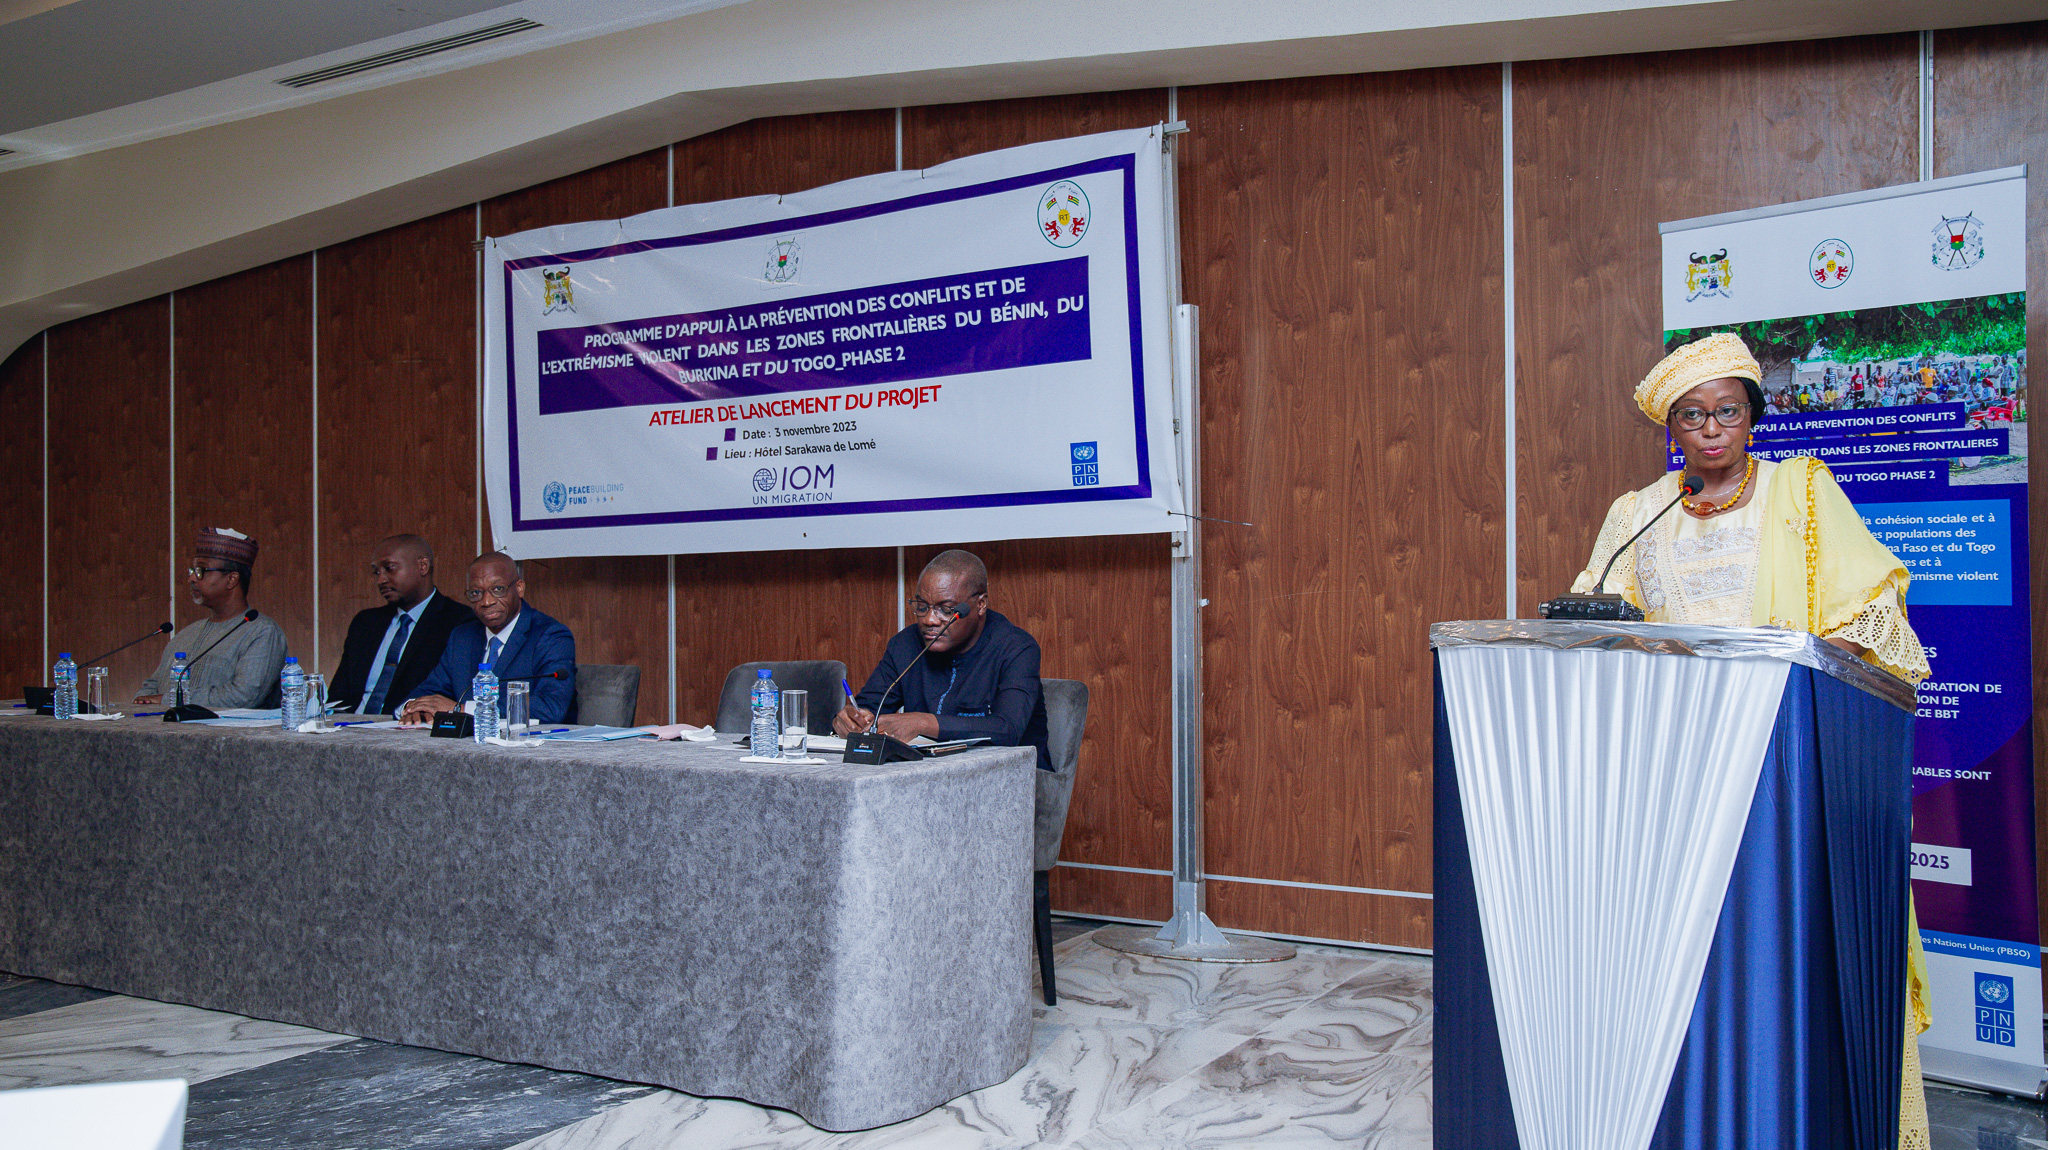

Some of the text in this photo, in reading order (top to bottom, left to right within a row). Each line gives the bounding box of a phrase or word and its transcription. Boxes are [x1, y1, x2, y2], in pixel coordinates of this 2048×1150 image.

[584, 326, 663, 348] PROGRAMME
[726, 314, 738, 332] À
[740, 315, 758, 330] LA
[760, 301, 853, 327] PRÉVENTION
[857, 296, 886, 314] DES
[890, 284, 971, 309] CONFLITS
[975, 280, 997, 298] ET
[1001, 277, 1026, 295] DE
[638, 346, 691, 365] VIOLENT
[698, 341, 739, 358] DANS
[746, 338, 770, 353] LES
[776, 330, 825, 350] ZONES
[832, 314, 946, 343] FRONTALIÈRES
[955, 309, 981, 327] DU
[990, 301, 1049, 323] BÉNIN,
[1057, 295, 1084, 314] DU
[678, 346, 906, 384] BURKINA ET DU TOGO_PHASE 2
[649, 384, 942, 427] ATELIER DE LANCEMENT DU PROJET
[1778, 423, 1788, 431] A
[1789, 422, 1803, 431] LA
[1805, 417, 1874, 430] PREVENTION
[1876, 415, 1897, 425] DES
[1899, 411, 1957, 424] CONFLITS
[742, 430, 766, 440] Date
[774, 427, 781, 437] 3
[783, 424, 831, 437] novembre
[832, 420, 857, 433] 2023
[724, 448, 746, 459] Lieu
[754, 446, 782, 459] Hôtel
[785, 443, 832, 456] Sarakawa
[833, 441, 846, 452] de
[848, 438, 876, 452] Lomé
[1672, 455, 1686, 464] ET
[1773, 448, 1819, 459] VIOLENT
[1820, 446, 1851, 456] DANS
[1853, 445, 1871, 454] LES
[1873, 443, 1911, 454] ZONES
[1912, 438, 1999, 452] FRONTALIERES
[781, 463, 834, 491] IOM
[1836, 470, 1936, 483] DU TOGO PHASE 2
[568, 483, 624, 495] PEACEBUILDING
[569, 496, 588, 505] FUND
[752, 492, 834, 505] UN MIGRATION
[1874, 514, 1924, 525] cohésion
[1927, 513, 1968, 524] sociale
[1971, 514, 1985, 523] et
[1988, 512, 1996, 523] à
[1885, 529, 1952, 541] populations
[1954, 528, 1976, 538] des
[1902, 543, 1928, 553] Faso
[1930, 544, 1944, 552] et
[1946, 543, 1963, 552] du
[1965, 542, 1996, 555] Togo
[1918, 558, 1932, 567] et
[1934, 557, 1942, 567] à
[1957, 571, 1999, 581] violent
[1984, 684, 2002, 694] DE
[1916, 695, 1960, 706] ION DE
[1934, 709, 1960, 719] BBT
[1954, 769, 1992, 781] SONT
[1910, 851, 1950, 870] 2025
[1933, 937, 1967, 949] Nations
[1969, 942, 1995, 953] Unies
[1997, 946, 2031, 960] (PBSO)
